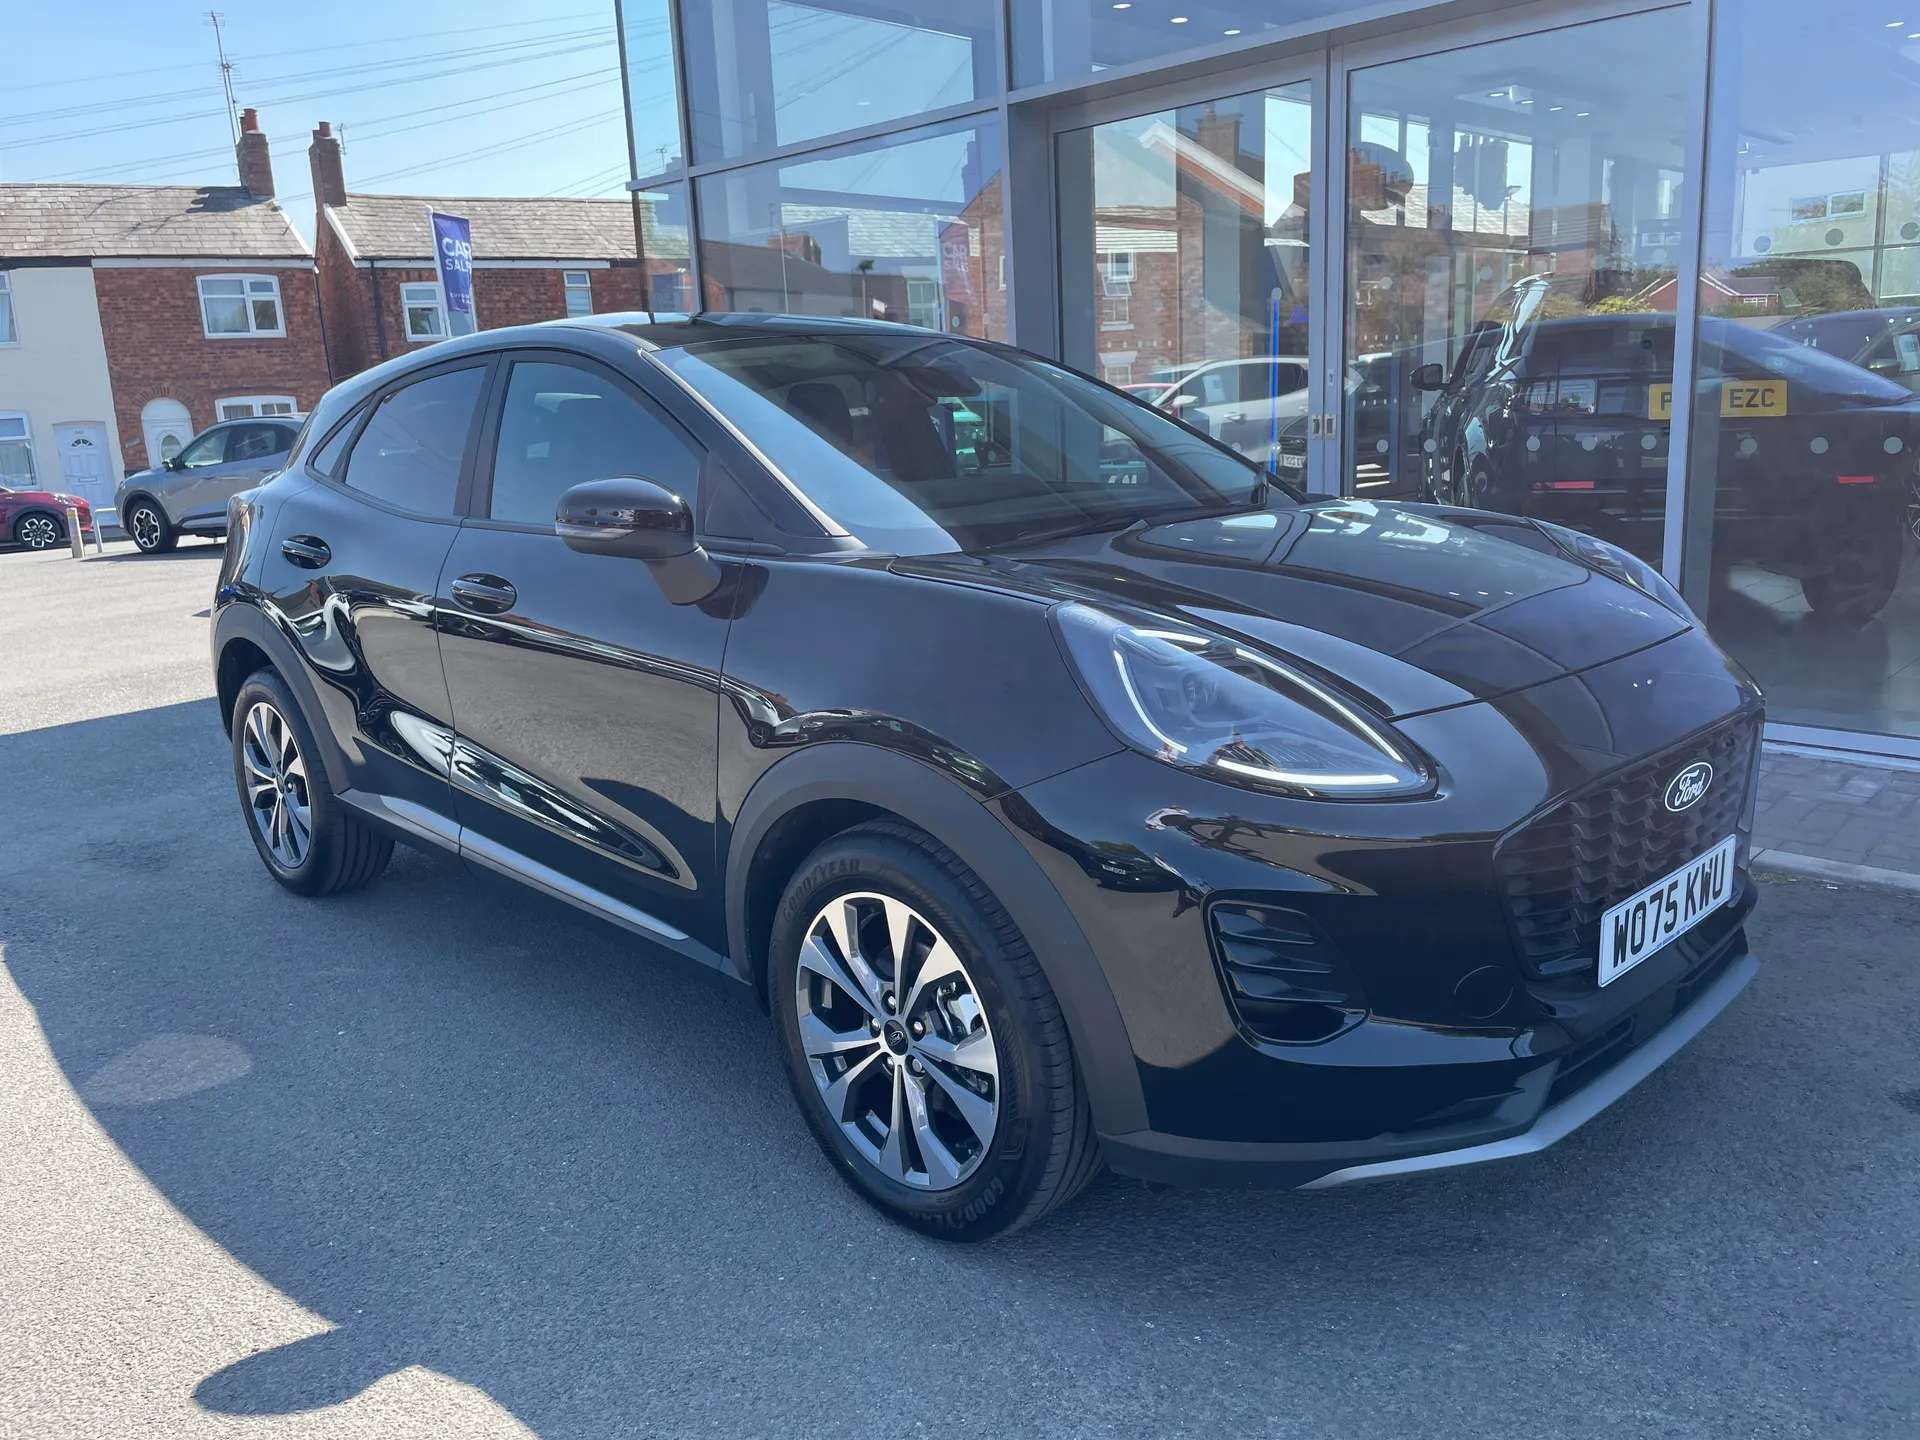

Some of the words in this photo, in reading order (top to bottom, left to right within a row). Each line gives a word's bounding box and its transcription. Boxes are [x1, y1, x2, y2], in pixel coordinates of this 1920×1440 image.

[1729, 388, 1775, 408] EZC
[1675, 769, 1705, 806] Ford
[1613, 880, 1678, 968] WO75
[1684, 849, 1726, 921] KWU
